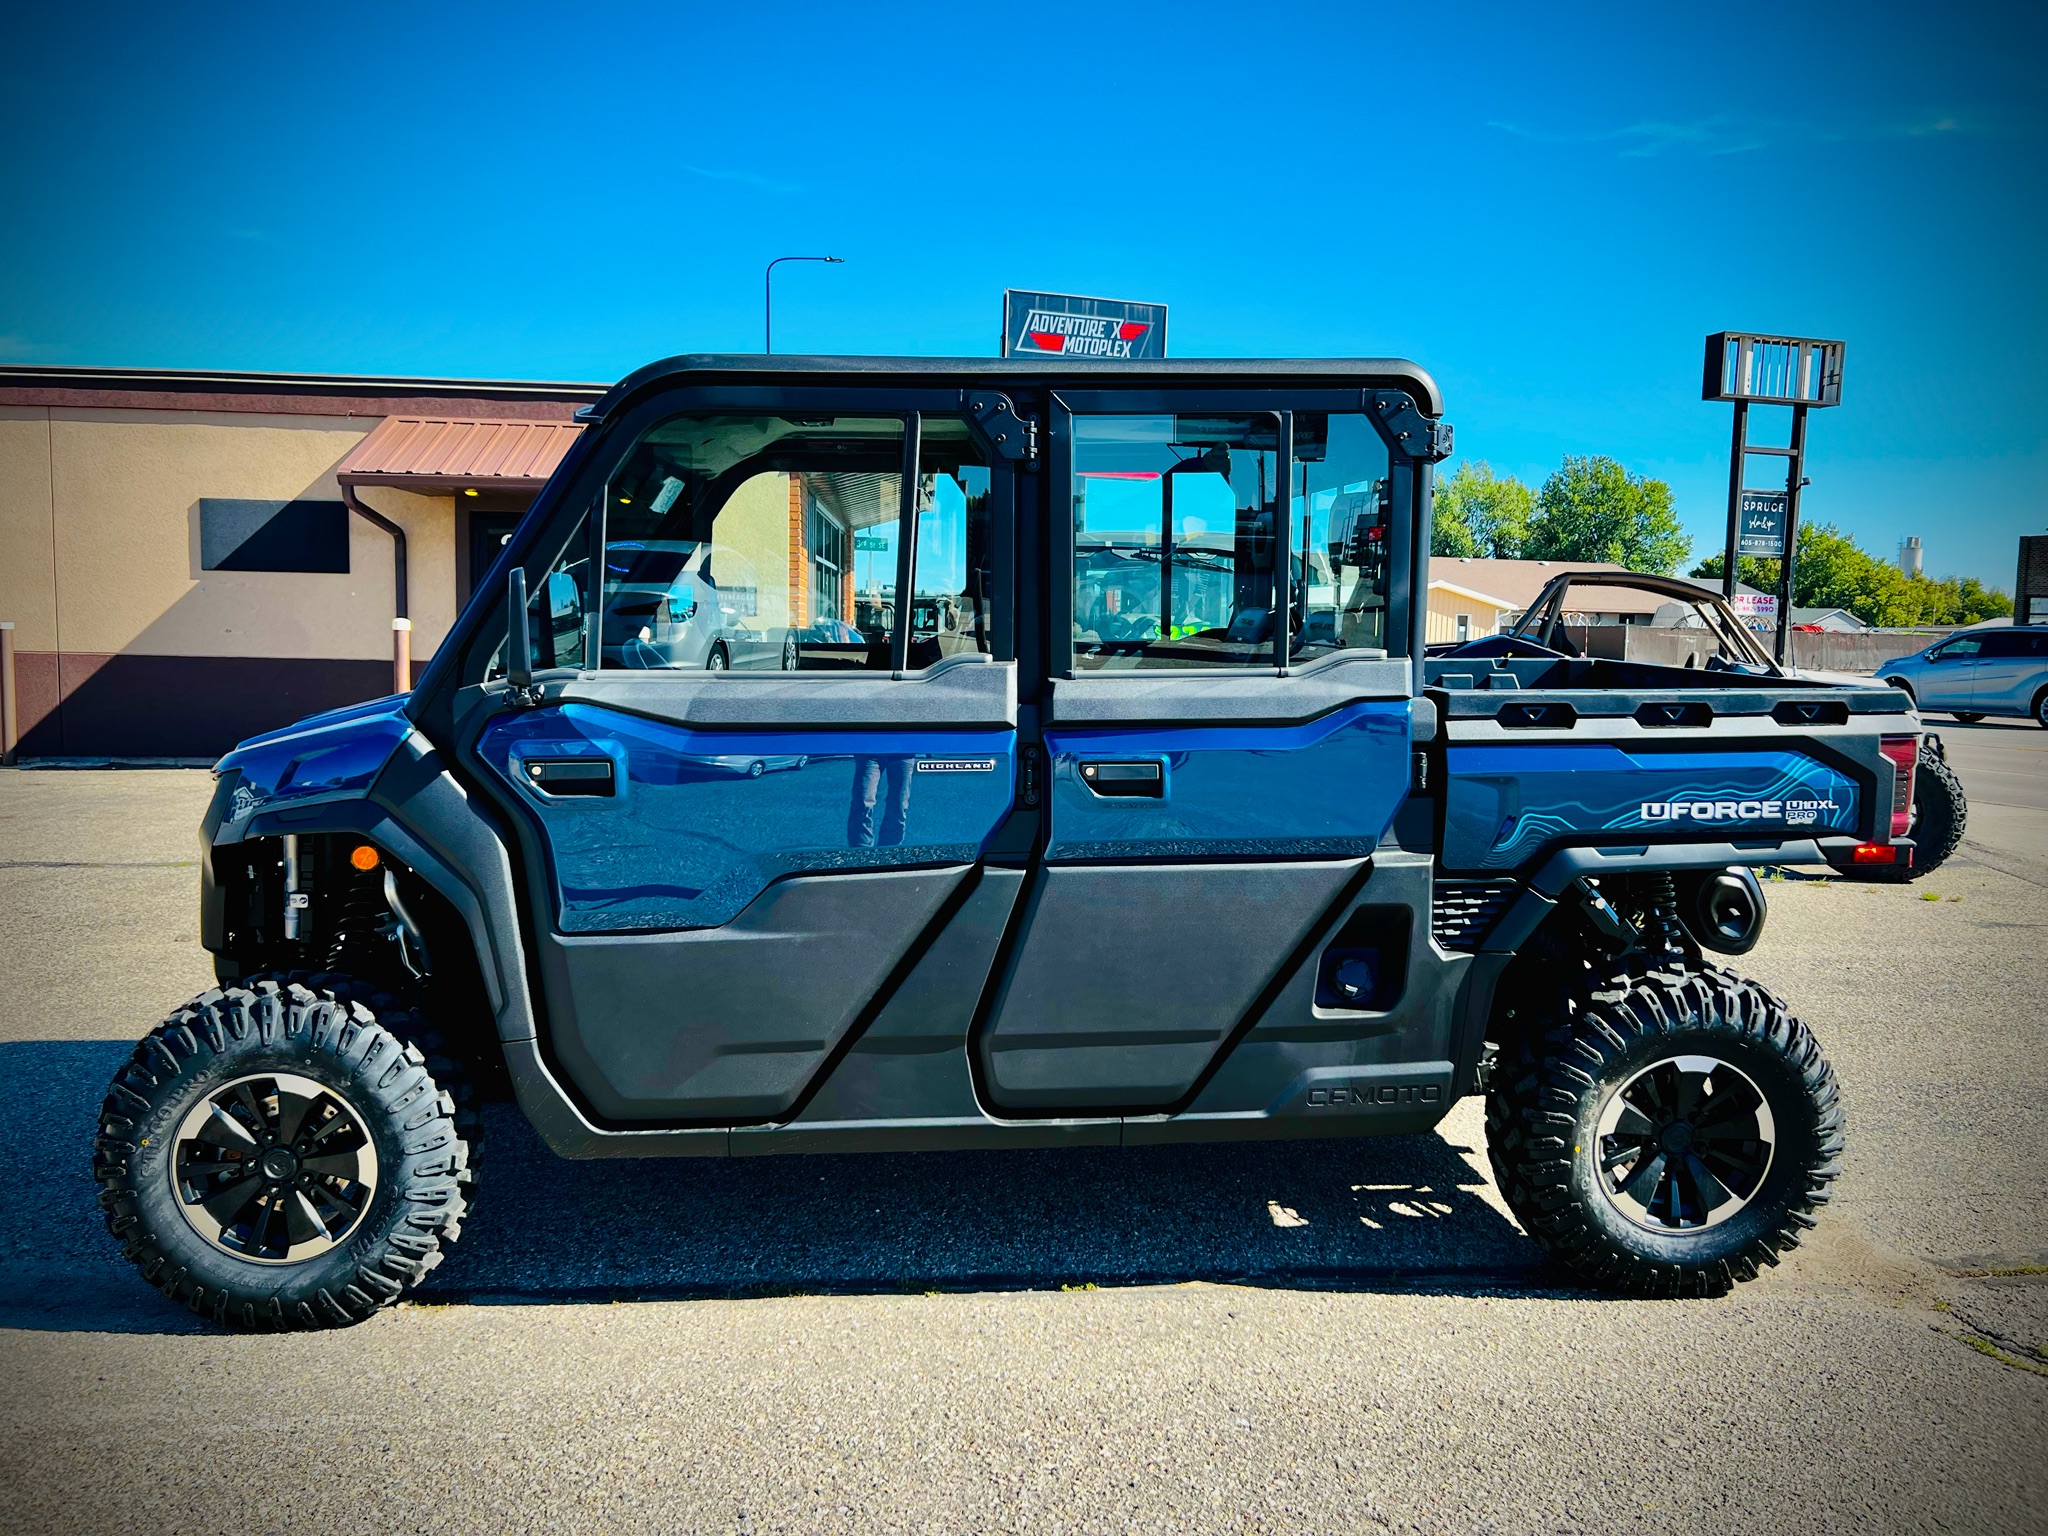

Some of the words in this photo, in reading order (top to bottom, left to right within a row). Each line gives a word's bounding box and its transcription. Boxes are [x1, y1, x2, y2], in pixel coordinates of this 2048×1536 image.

[1030, 314, 1107, 338] ADVENTURE
[1111, 321, 1124, 339] X
[1063, 335, 1132, 358] MOTOPLEX
[1743, 501, 1784, 513] SPRUCE
[1746, 596, 1774, 604] LEASE
[1640, 800, 1783, 821] UFORCE
[1785, 800, 1839, 810] U10XL
[1785, 811, 1817, 820] PRO
[1306, 1084, 1442, 1107] CFMOTO
